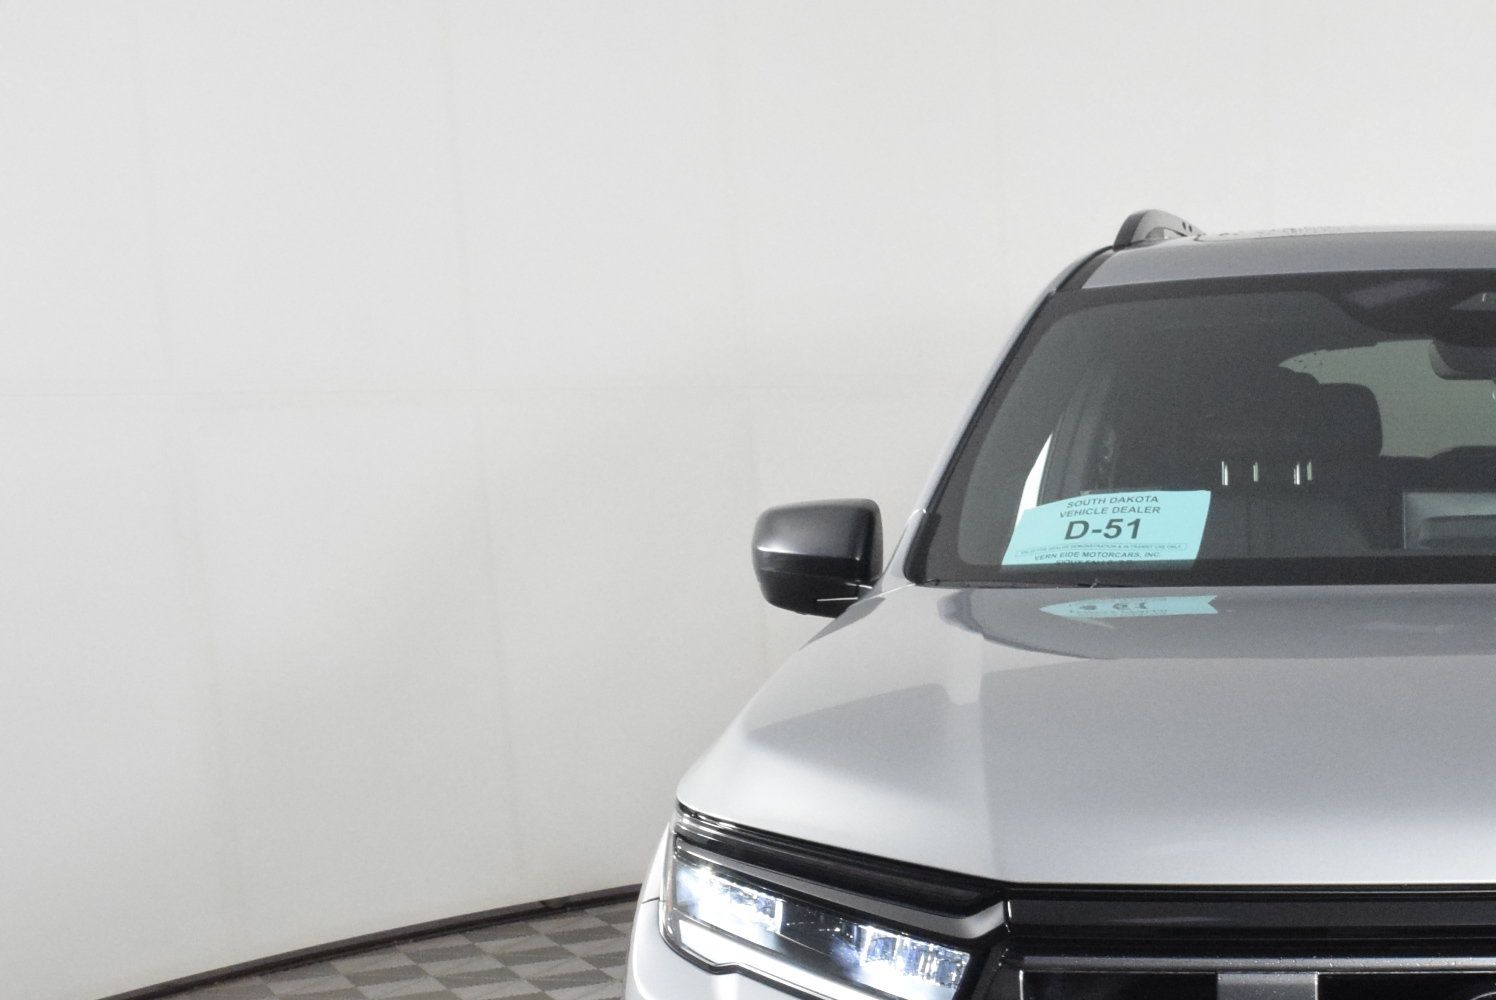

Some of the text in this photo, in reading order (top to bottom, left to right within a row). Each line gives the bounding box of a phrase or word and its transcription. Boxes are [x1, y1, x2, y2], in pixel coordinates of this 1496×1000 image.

[1066, 495, 1159, 509] SOUTH DAKOTA
[1060, 506, 1161, 518] VEHICLE DEALER
[1063, 518, 1141, 540] D-51
[1034, 552, 1057, 561] VERN
